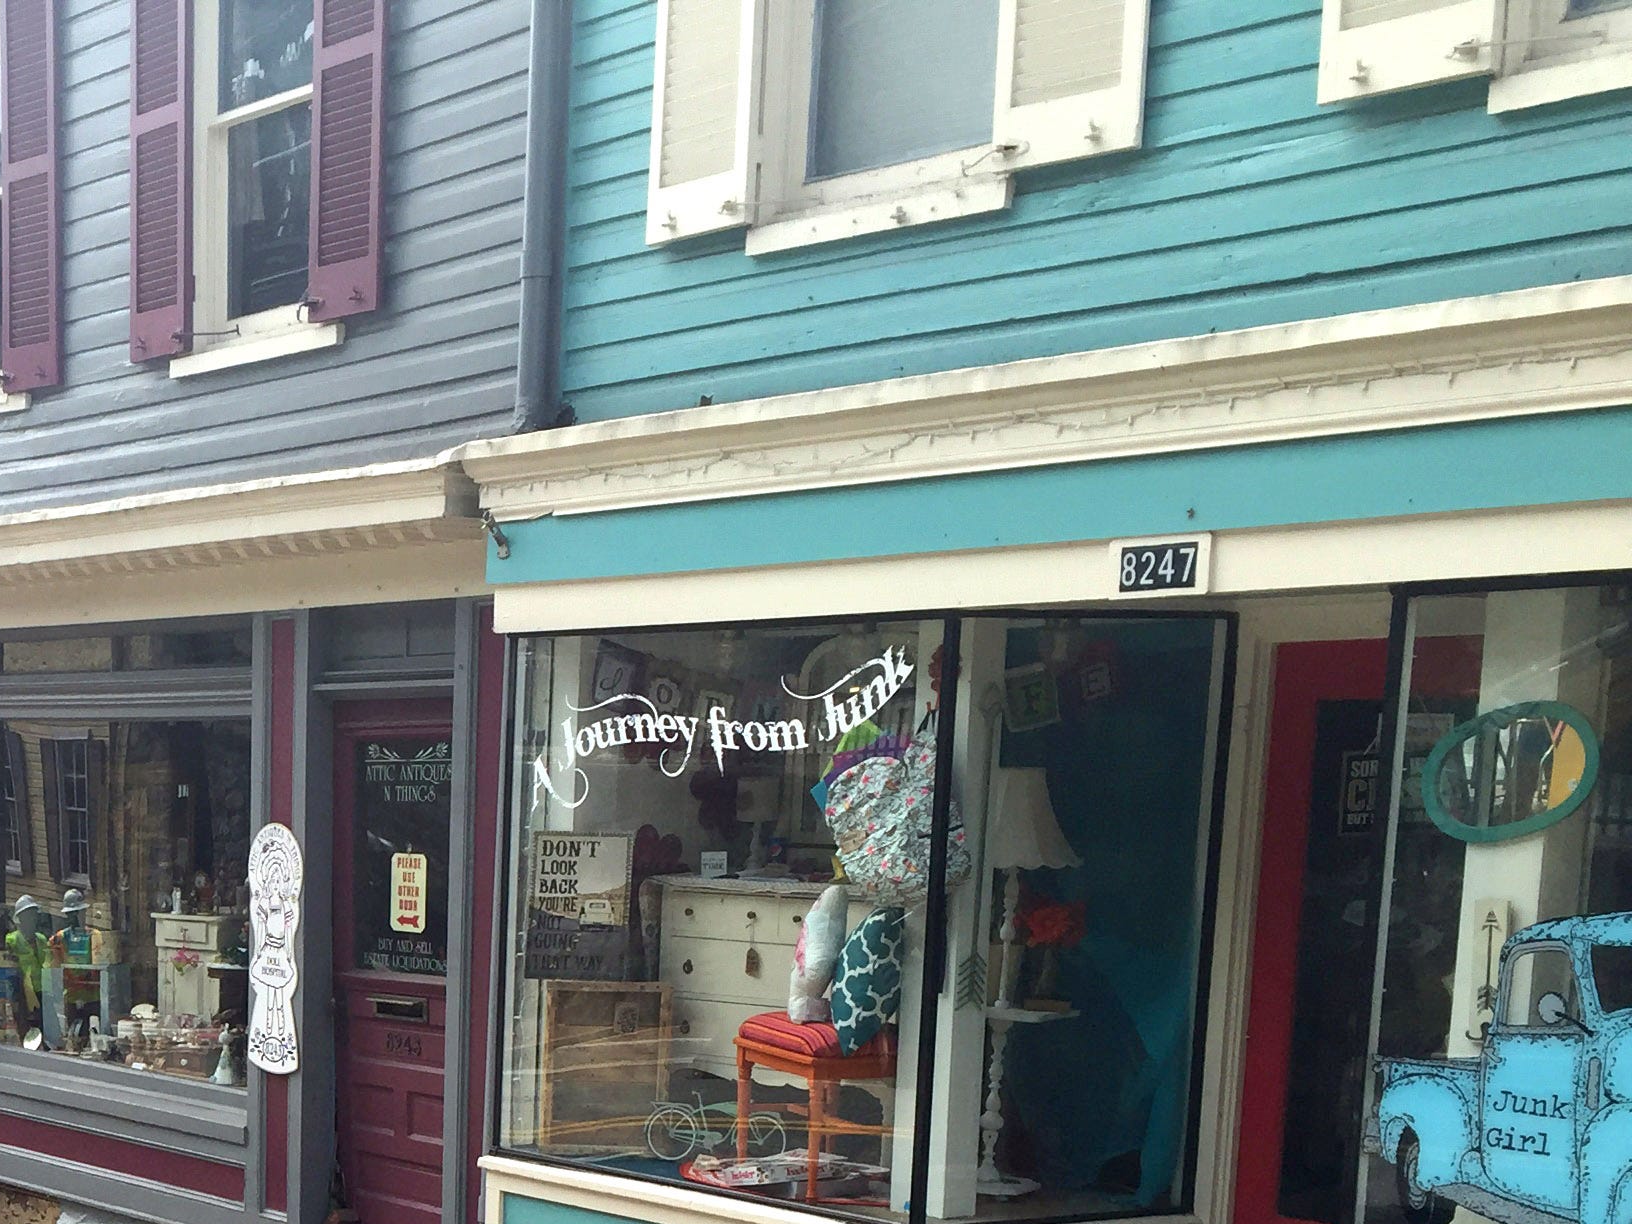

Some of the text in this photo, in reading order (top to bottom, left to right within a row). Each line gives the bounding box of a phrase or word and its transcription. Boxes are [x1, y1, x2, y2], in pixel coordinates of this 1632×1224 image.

[1121, 547, 1196, 587] 8247
[780, 645, 915, 742] Junk
[558, 694, 700, 778] Journey
[706, 705, 810, 778] from
[365, 763, 452, 785] ATTIC ANTIQUES
[530, 753, 589, 813] A
[395, 785, 437, 803] THINGS
[541, 839, 601, 858] DON'T
[396, 857, 422, 870] PLEASE
[540, 859, 579, 876] LOOK
[402, 871, 416, 884] USE
[538, 878, 579, 895] BACK
[397, 885, 420, 899] OTHER
[398, 899, 419, 912] DOOR
[538, 896, 579, 913] YOU'RE
[536, 913, 562, 931] NOT
[377, 937, 433, 956] BUY AND SELL
[534, 932, 581, 951] GOING
[575, 955, 603, 972] WAY
[386, 1031, 423, 1057] 8243
[1492, 1090, 1570, 1119] Junk
[1486, 1126, 1551, 1157] Girl
